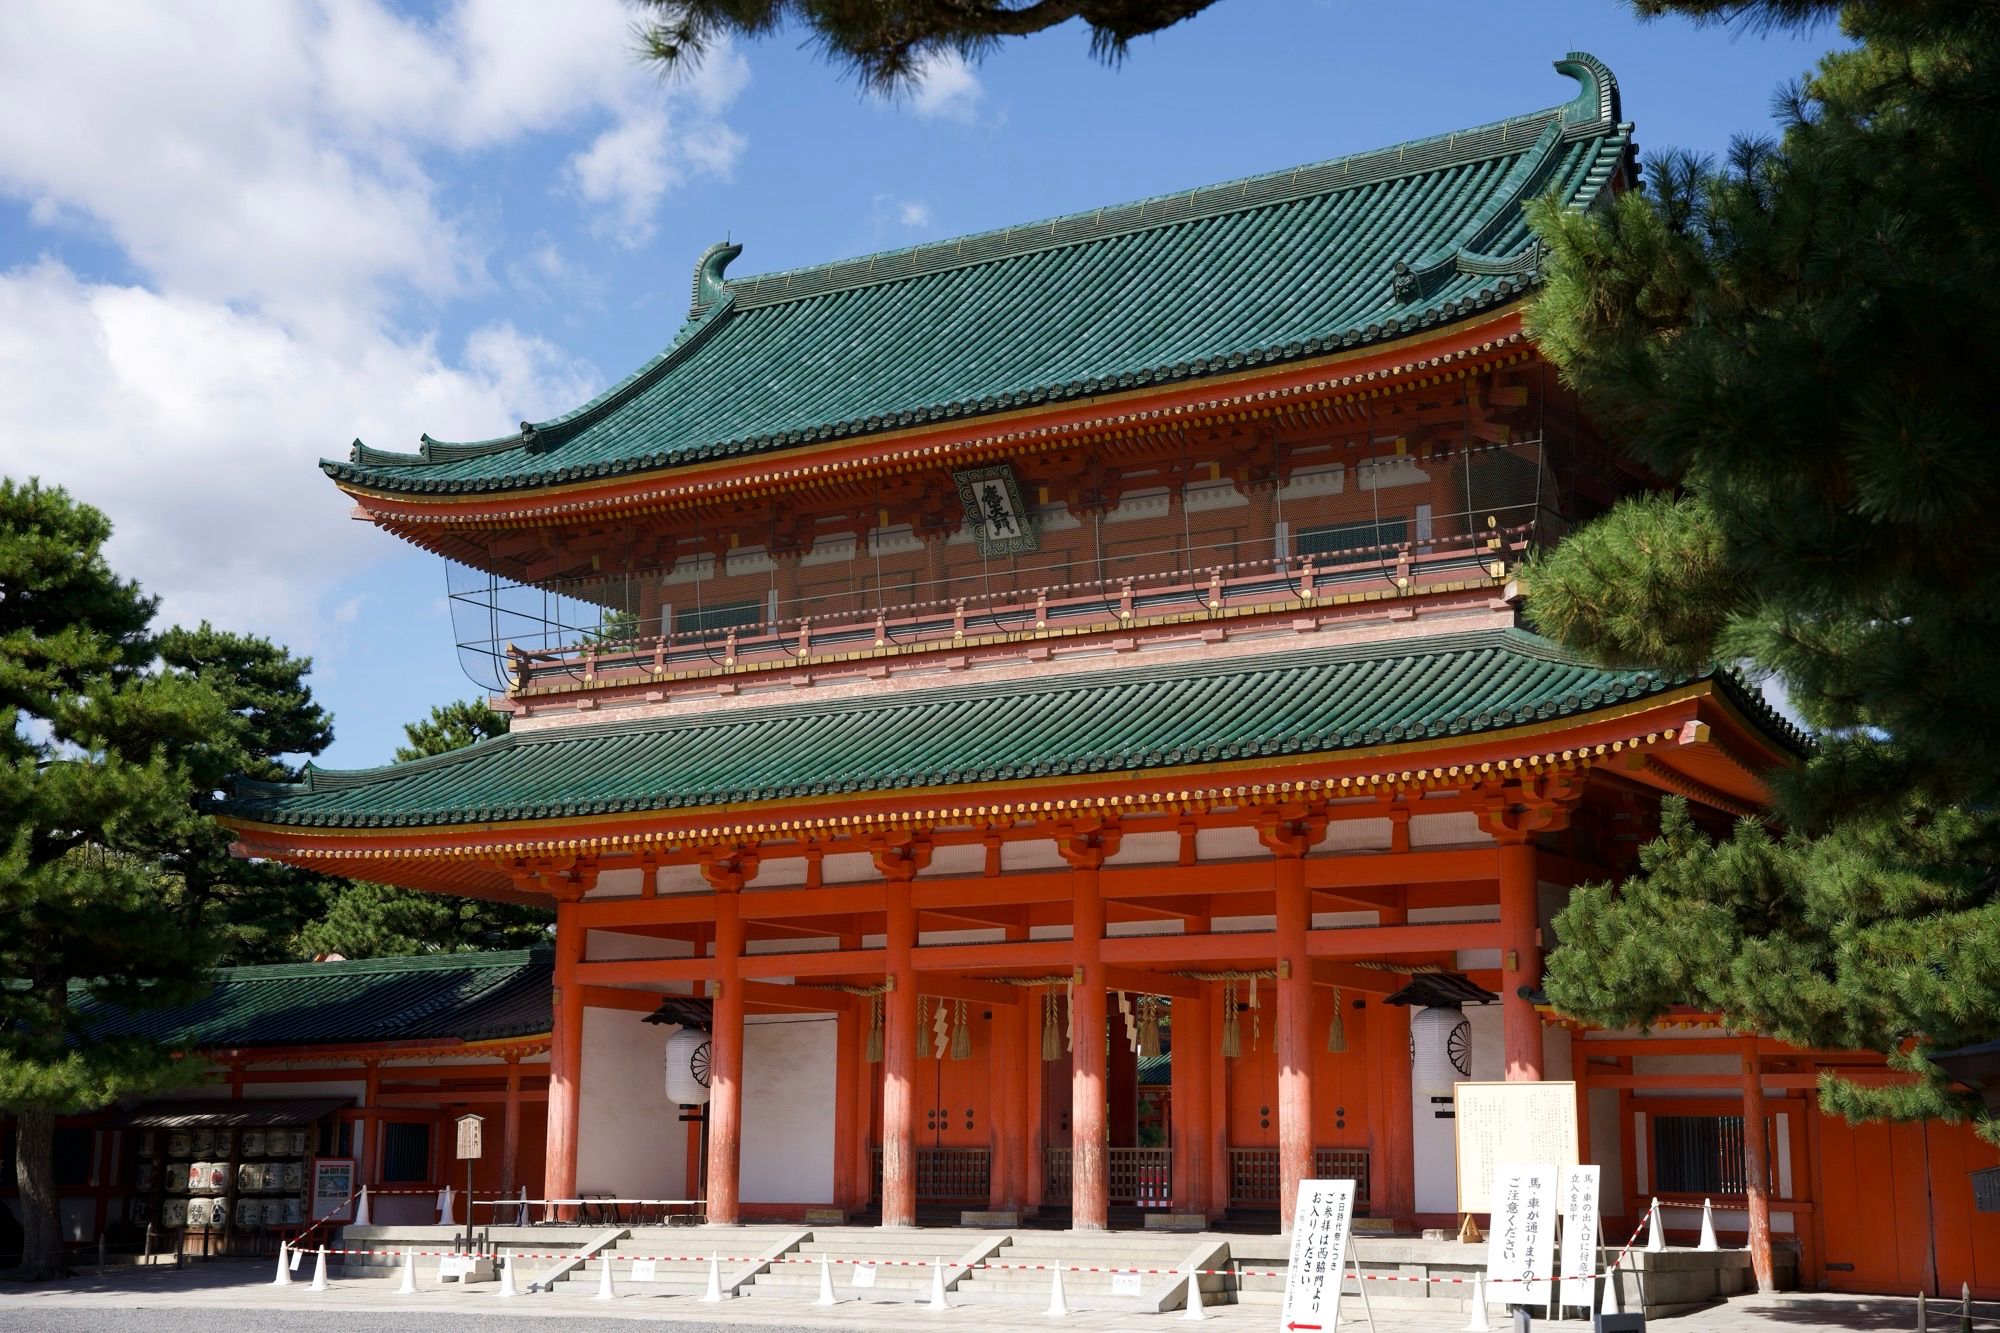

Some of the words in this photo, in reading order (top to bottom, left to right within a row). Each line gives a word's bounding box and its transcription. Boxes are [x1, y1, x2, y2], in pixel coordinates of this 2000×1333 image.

[1311, 1191, 1335, 1313] ご参拝は西脇門より
[1503, 1177, 1521, 1264] ご注意ください。
[1522, 1177, 1541, 1292] 馬・車が通りますので
